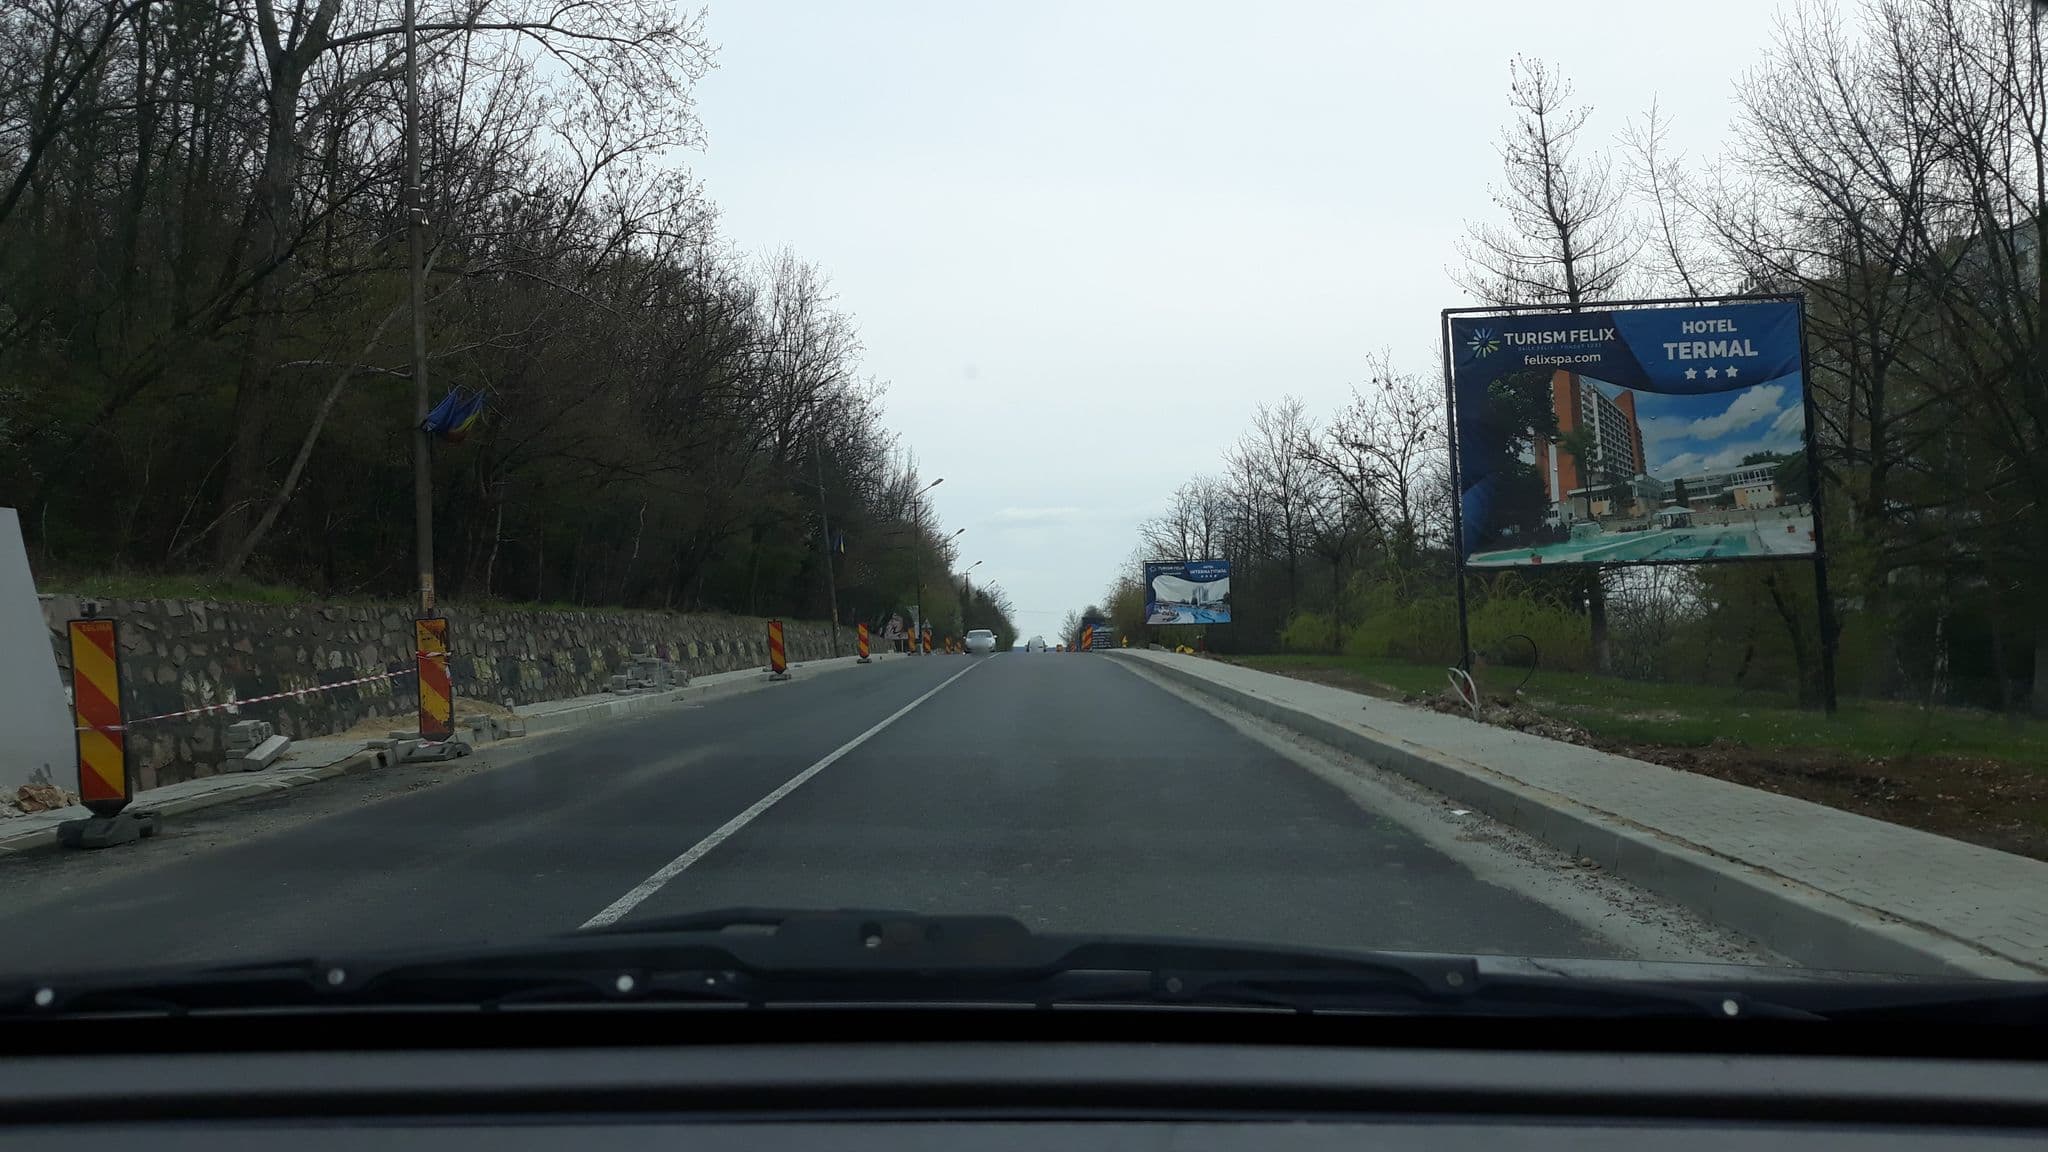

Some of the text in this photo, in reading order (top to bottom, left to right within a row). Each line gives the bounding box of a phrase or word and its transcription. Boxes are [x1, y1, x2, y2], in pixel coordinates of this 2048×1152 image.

[1682, 319, 1737, 334] HOTEL
[1504, 328, 1615, 345] TURISM FELIX
[1663, 339, 1758, 360] TERMAL
[1524, 353, 1601, 366] felixspa.com
